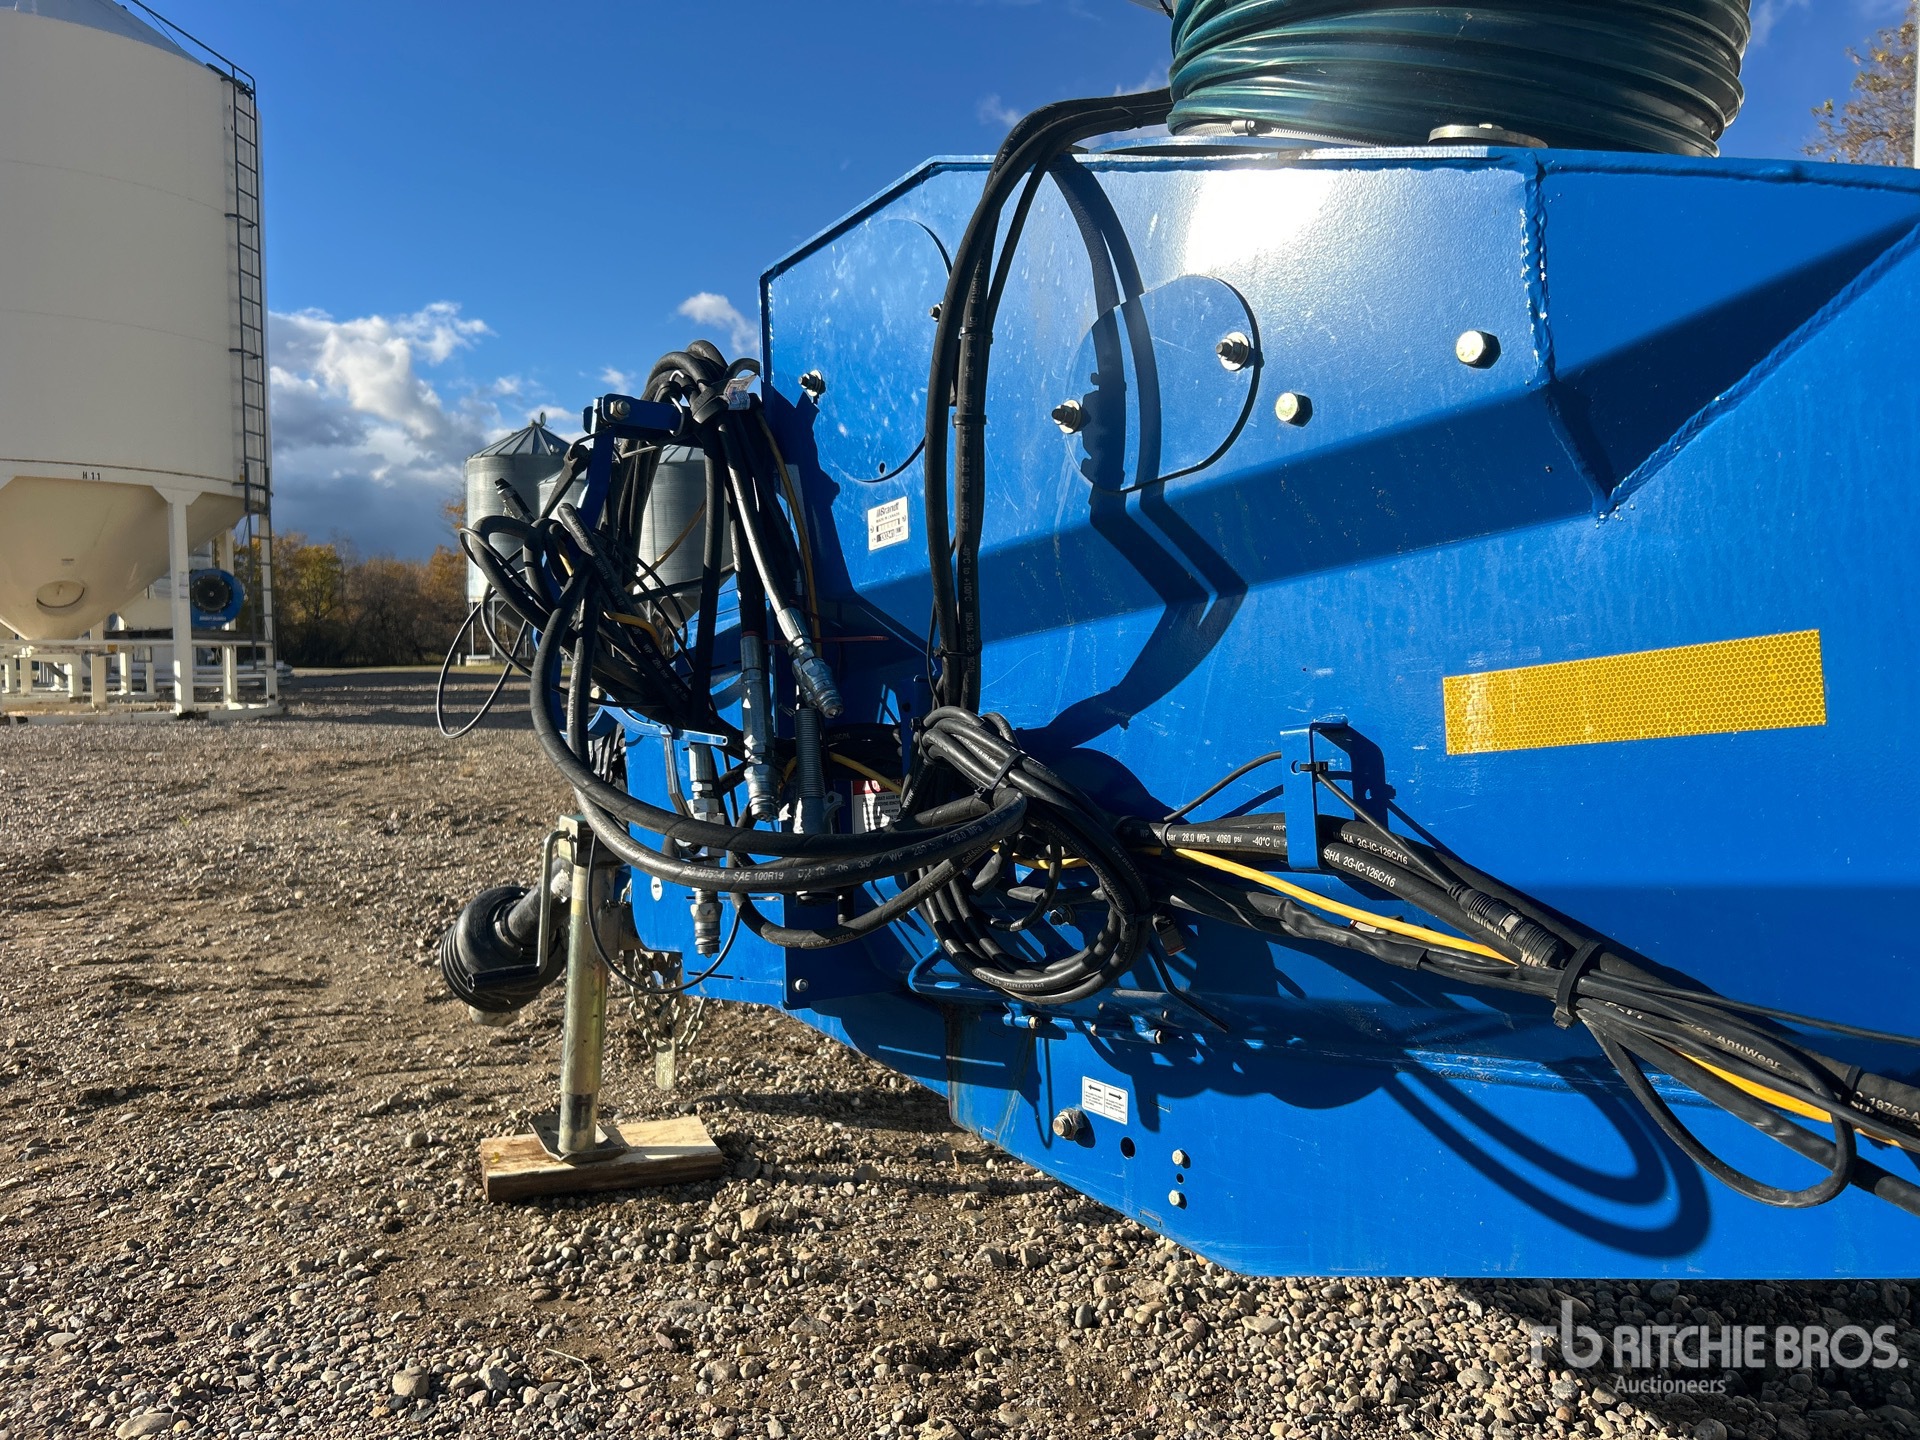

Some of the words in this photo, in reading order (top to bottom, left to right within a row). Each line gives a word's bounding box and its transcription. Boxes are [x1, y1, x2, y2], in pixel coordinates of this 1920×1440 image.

[964, 612, 973, 631] MSHA
[1181, 832, 1195, 843] 28.0
[1196, 833, 1210, 844] MPa
[1216, 834, 1231, 845] 4060
[733, 871, 751, 882] SAE
[754, 870, 784, 881] 100R19
[888, 850, 903, 863] WP
[1343, 856, 1396, 887] 2G-IC-126C/16
[1717, 1034, 1781, 1070] AntiWear
[1869, 1097, 1920, 1122] 18752-A
